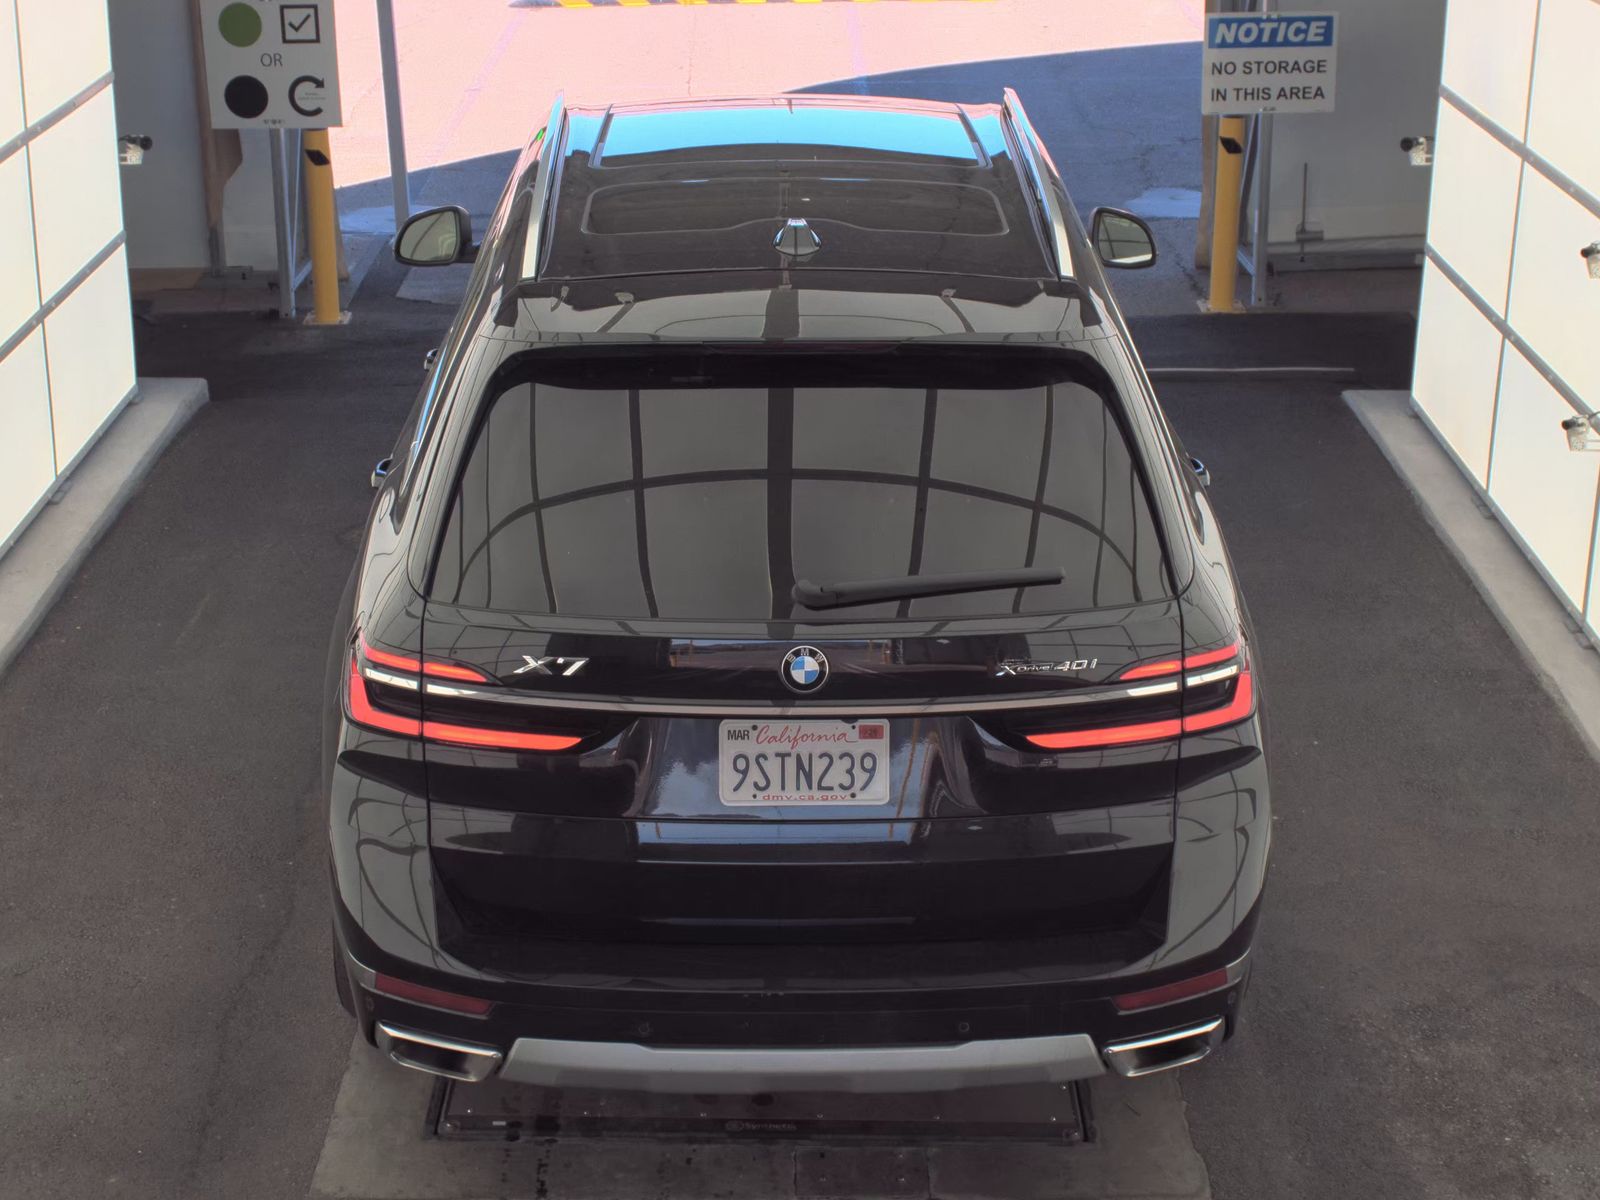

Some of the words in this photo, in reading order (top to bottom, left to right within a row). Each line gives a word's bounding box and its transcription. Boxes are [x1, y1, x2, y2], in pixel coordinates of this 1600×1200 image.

[1215, 21, 1327, 44] NOTICE
[260, 53, 283, 67] OR
[1211, 61, 1237, 75] NO
[1242, 59, 1327, 75] STORAGE
[1211, 88, 1227, 102] IN
[1233, 87, 1271, 101] THIS
[1276, 86, 1325, 100] AREA
[513, 655, 590, 676] X7
[727, 729, 750, 741] MAR
[755, 724, 858, 749] California
[732, 752, 877, 791] 9STN239
[762, 792, 848, 801] dmv.ca.gov
